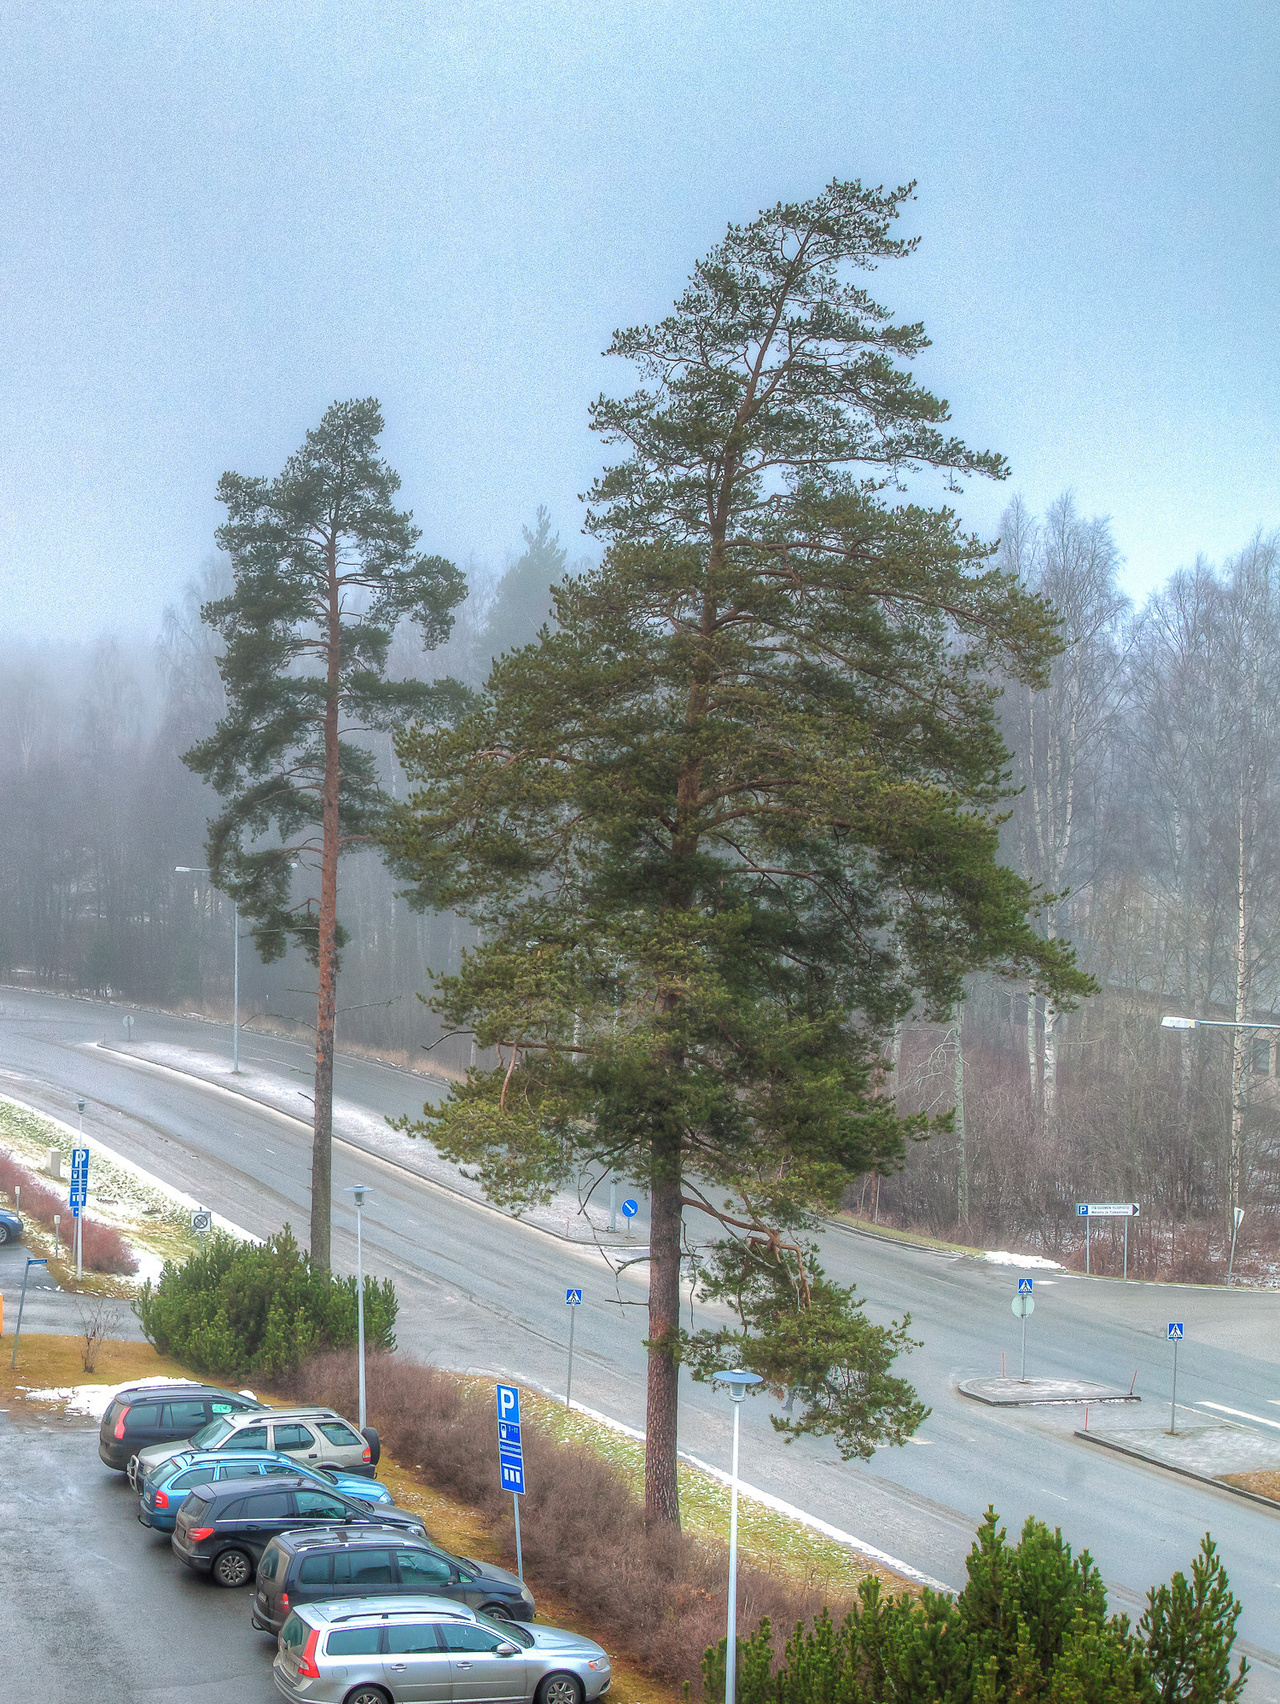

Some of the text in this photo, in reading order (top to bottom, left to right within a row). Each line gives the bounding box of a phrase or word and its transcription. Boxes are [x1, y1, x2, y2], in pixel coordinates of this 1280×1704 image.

[75, 1151, 86, 1167] P
[1080, 1206, 1087, 1214] P
[500, 1388, 515, 1418] P
